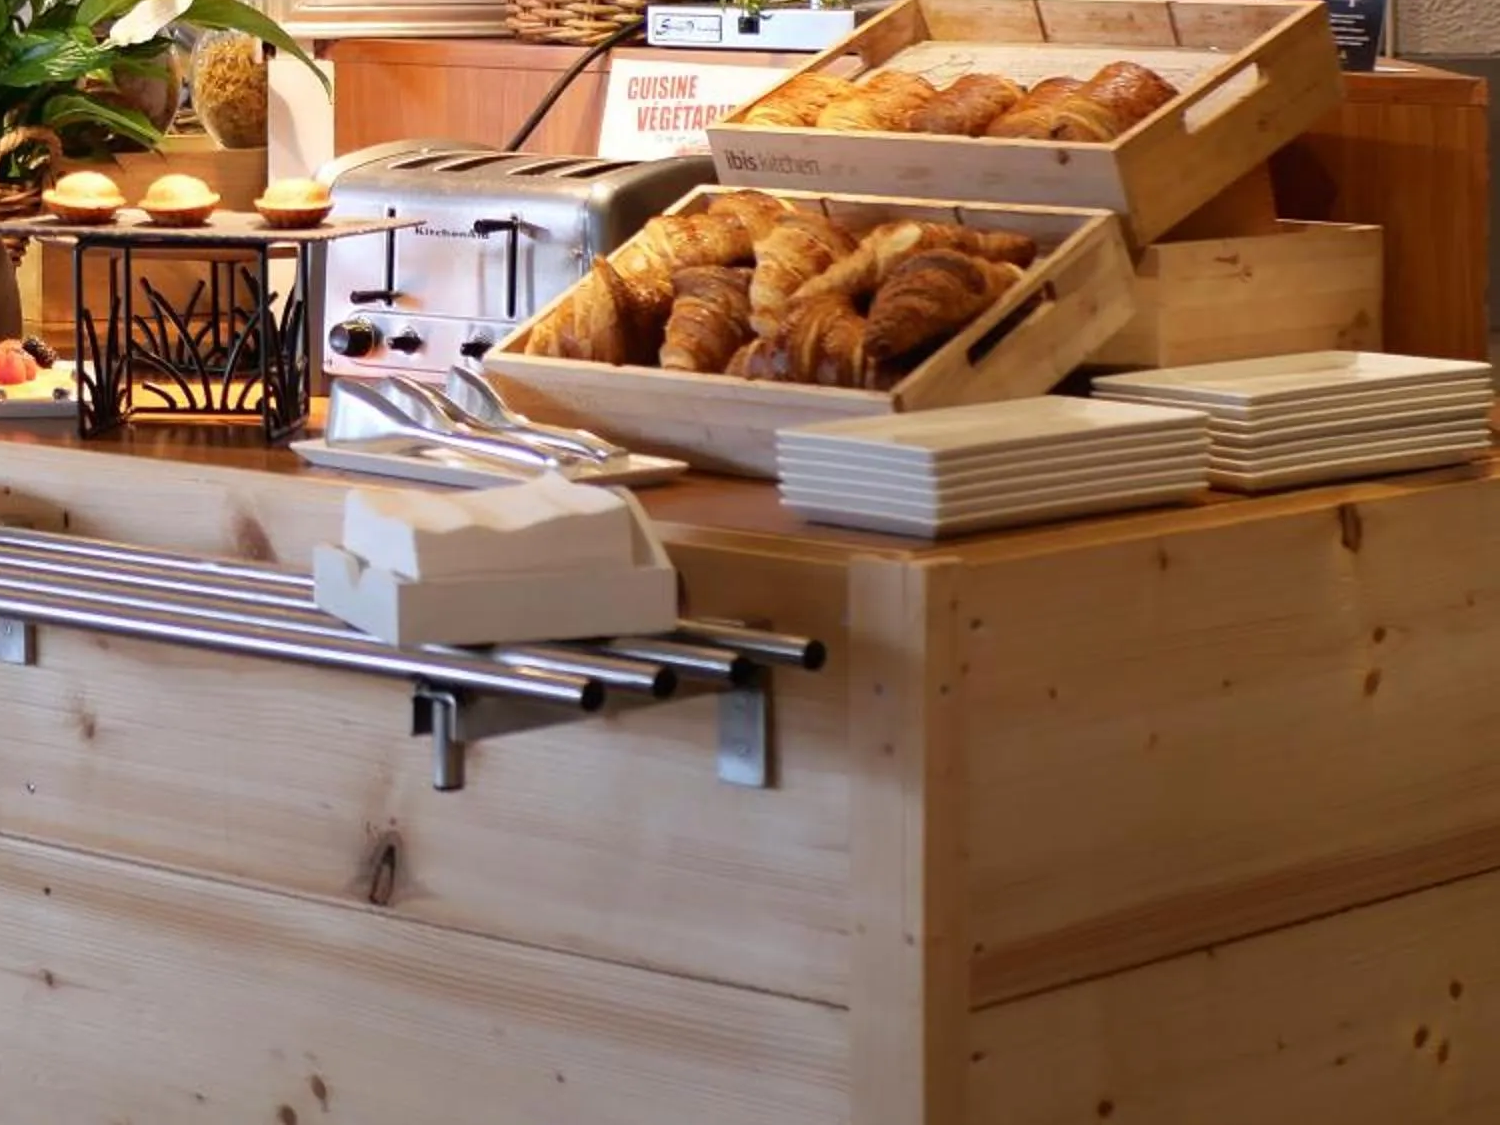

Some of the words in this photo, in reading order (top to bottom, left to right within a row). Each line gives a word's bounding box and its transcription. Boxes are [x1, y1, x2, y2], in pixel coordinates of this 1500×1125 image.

[627, 75, 699, 100] CUISINE
[726, 150, 759, 172] ibis
[414, 226, 490, 241] KitchenAid
